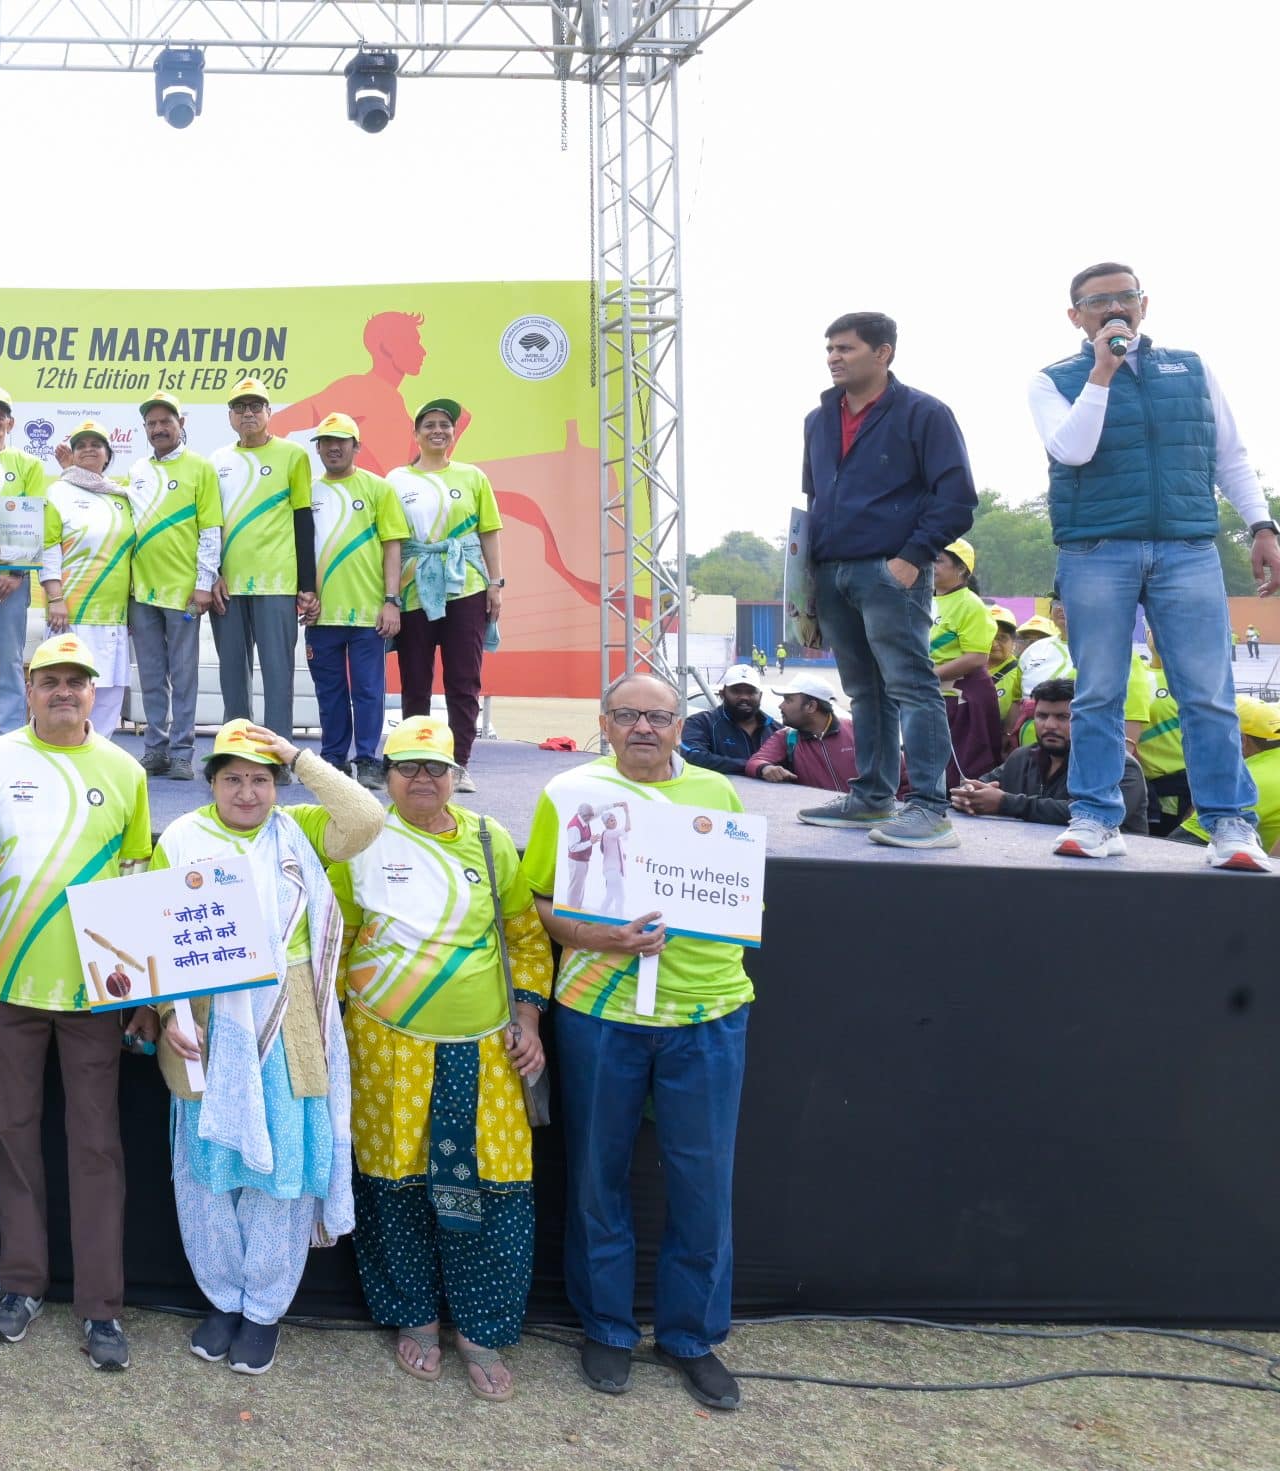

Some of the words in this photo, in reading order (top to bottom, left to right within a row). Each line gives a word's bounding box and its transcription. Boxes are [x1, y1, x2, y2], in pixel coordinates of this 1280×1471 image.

[88, 327, 287, 362] MARATHON
[35, 367, 77, 389] 12th
[83, 367, 150, 390] Edition
[157, 368, 186, 391] 1st
[190, 368, 227, 390] FEB
[724, 829, 749, 838] Apollo
[690, 867, 750, 888] wheels
[654, 879, 674, 897] to
[210, 902, 225, 916] के
[173, 929, 192, 946] दर्द
[194, 926, 213, 942] को
[215, 921, 237, 939] करें
[173, 950, 209, 968] क्लीन
